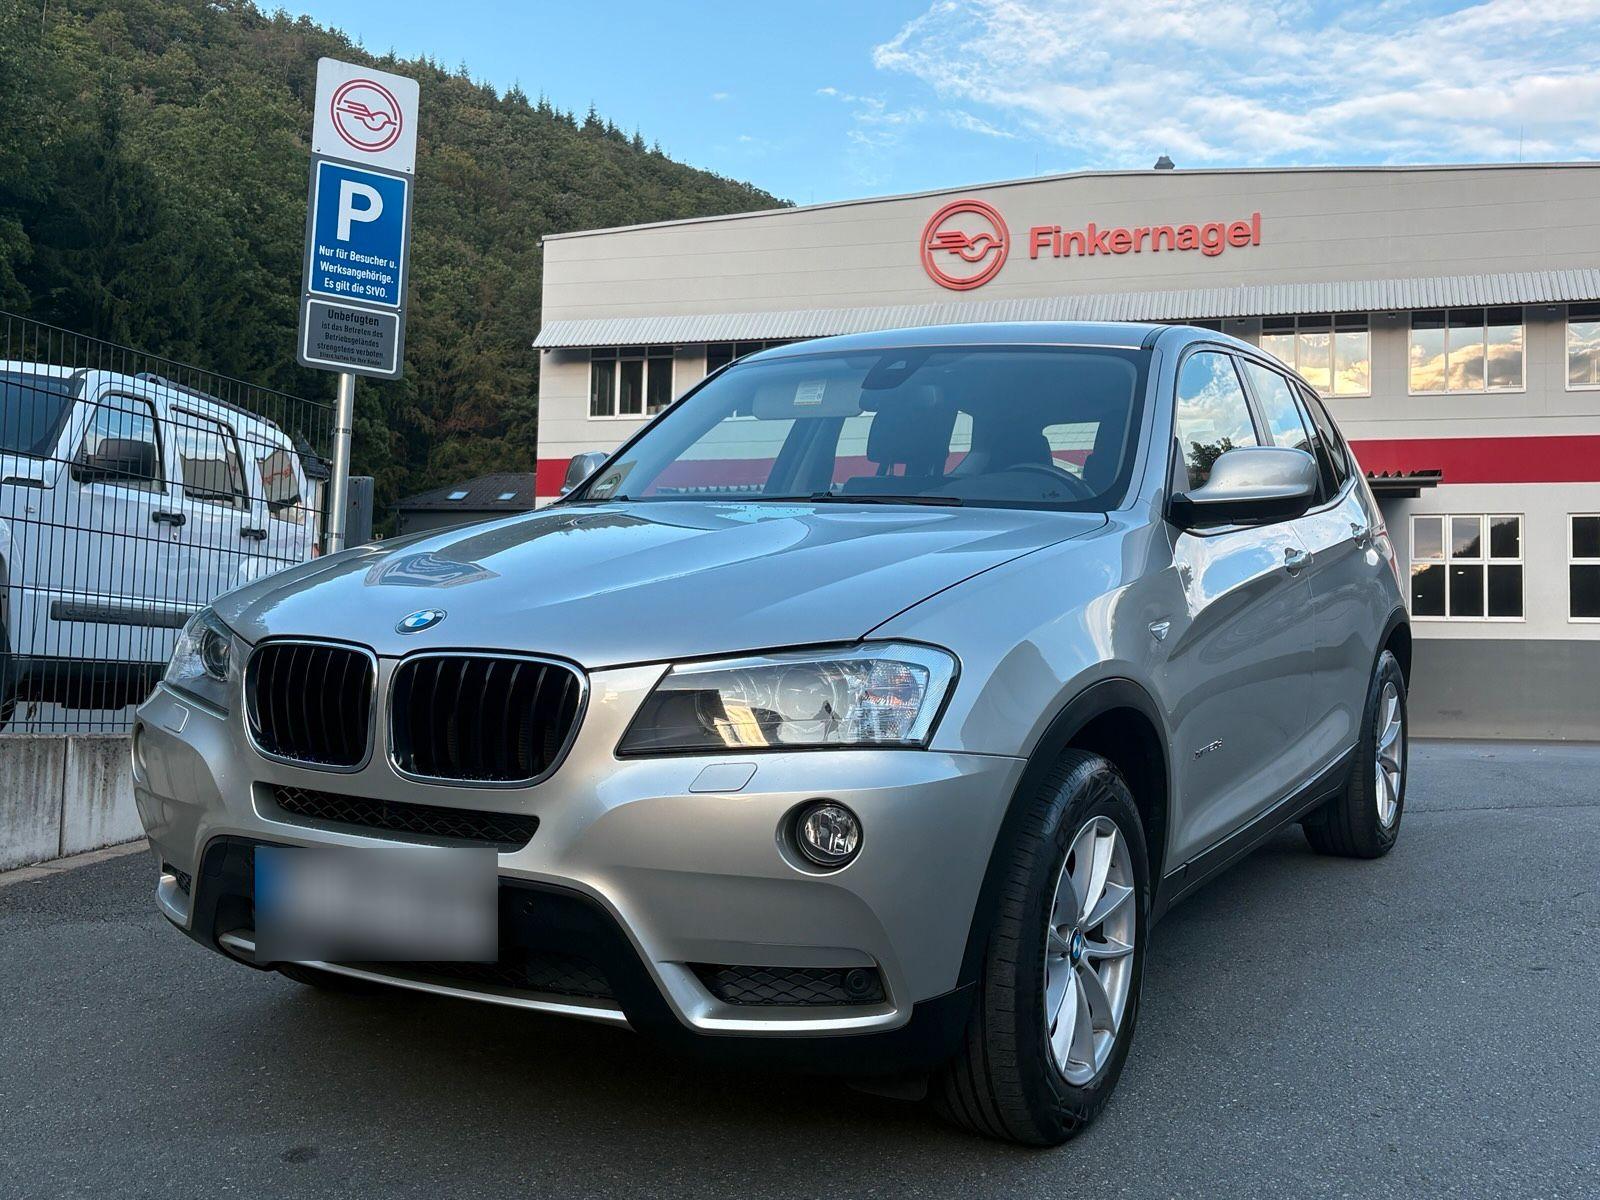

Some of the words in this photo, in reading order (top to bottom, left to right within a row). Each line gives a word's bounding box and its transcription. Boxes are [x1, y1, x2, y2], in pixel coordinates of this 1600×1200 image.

[336, 179, 384, 242] P
[1029, 212, 1262, 260] Finkernagel
[319, 245, 334, 257] Nur
[336, 248, 349, 260] für
[350, 251, 388, 267] Besucher
[389, 260, 397, 269] u.
[320, 261, 394, 285] Werksangehörige.
[324, 277, 334, 288] Es
[336, 281, 350, 292] gilt
[351, 283, 364, 293] die
[366, 285, 388, 298] StVO.
[321, 321, 330, 330] ist
[331, 323, 342, 332] das
[344, 325, 371, 336] Betreten
[328, 309, 379, 327] Unbefugten
